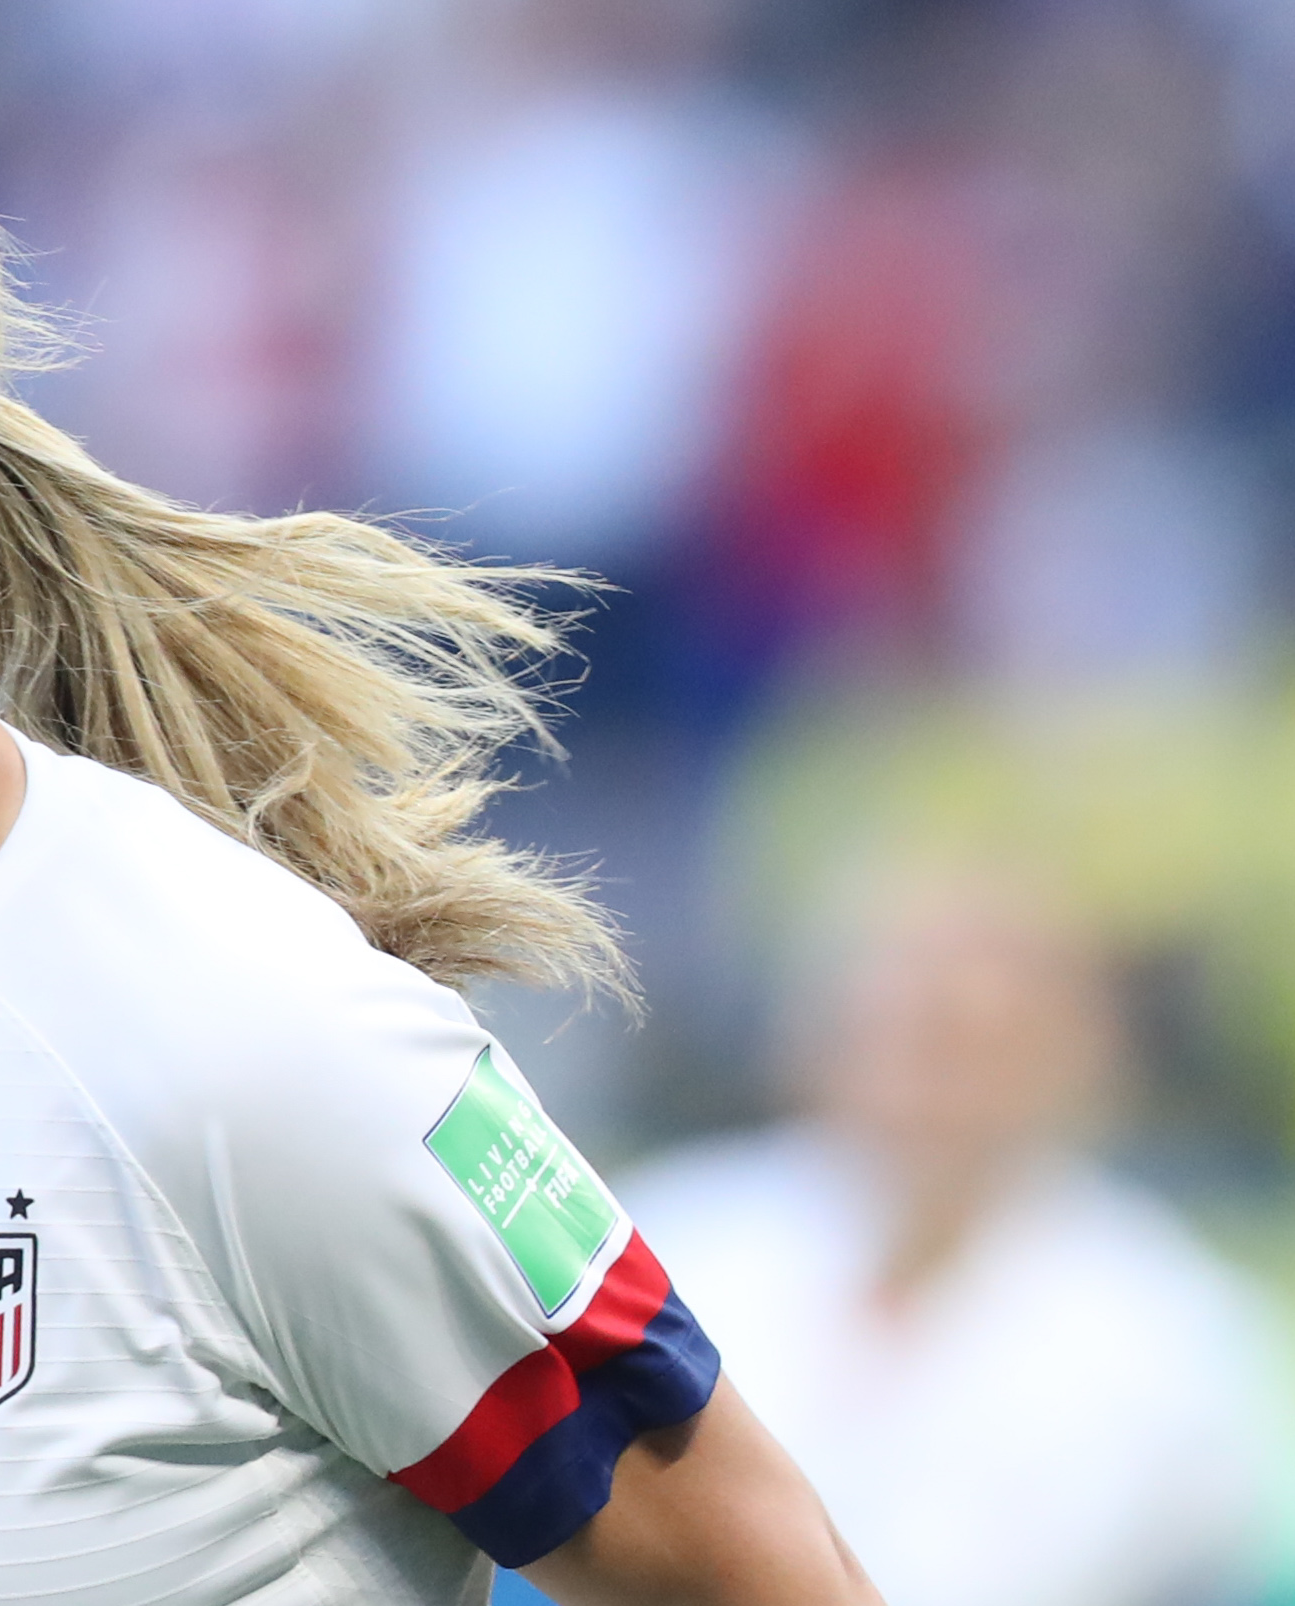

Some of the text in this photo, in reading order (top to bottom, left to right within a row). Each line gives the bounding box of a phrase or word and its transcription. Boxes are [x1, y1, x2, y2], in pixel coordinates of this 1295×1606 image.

[468, 1100, 532, 1195] LIVING
[483, 1123, 548, 1215] FOOTBALL
[543, 1158, 581, 1209] FIFA
